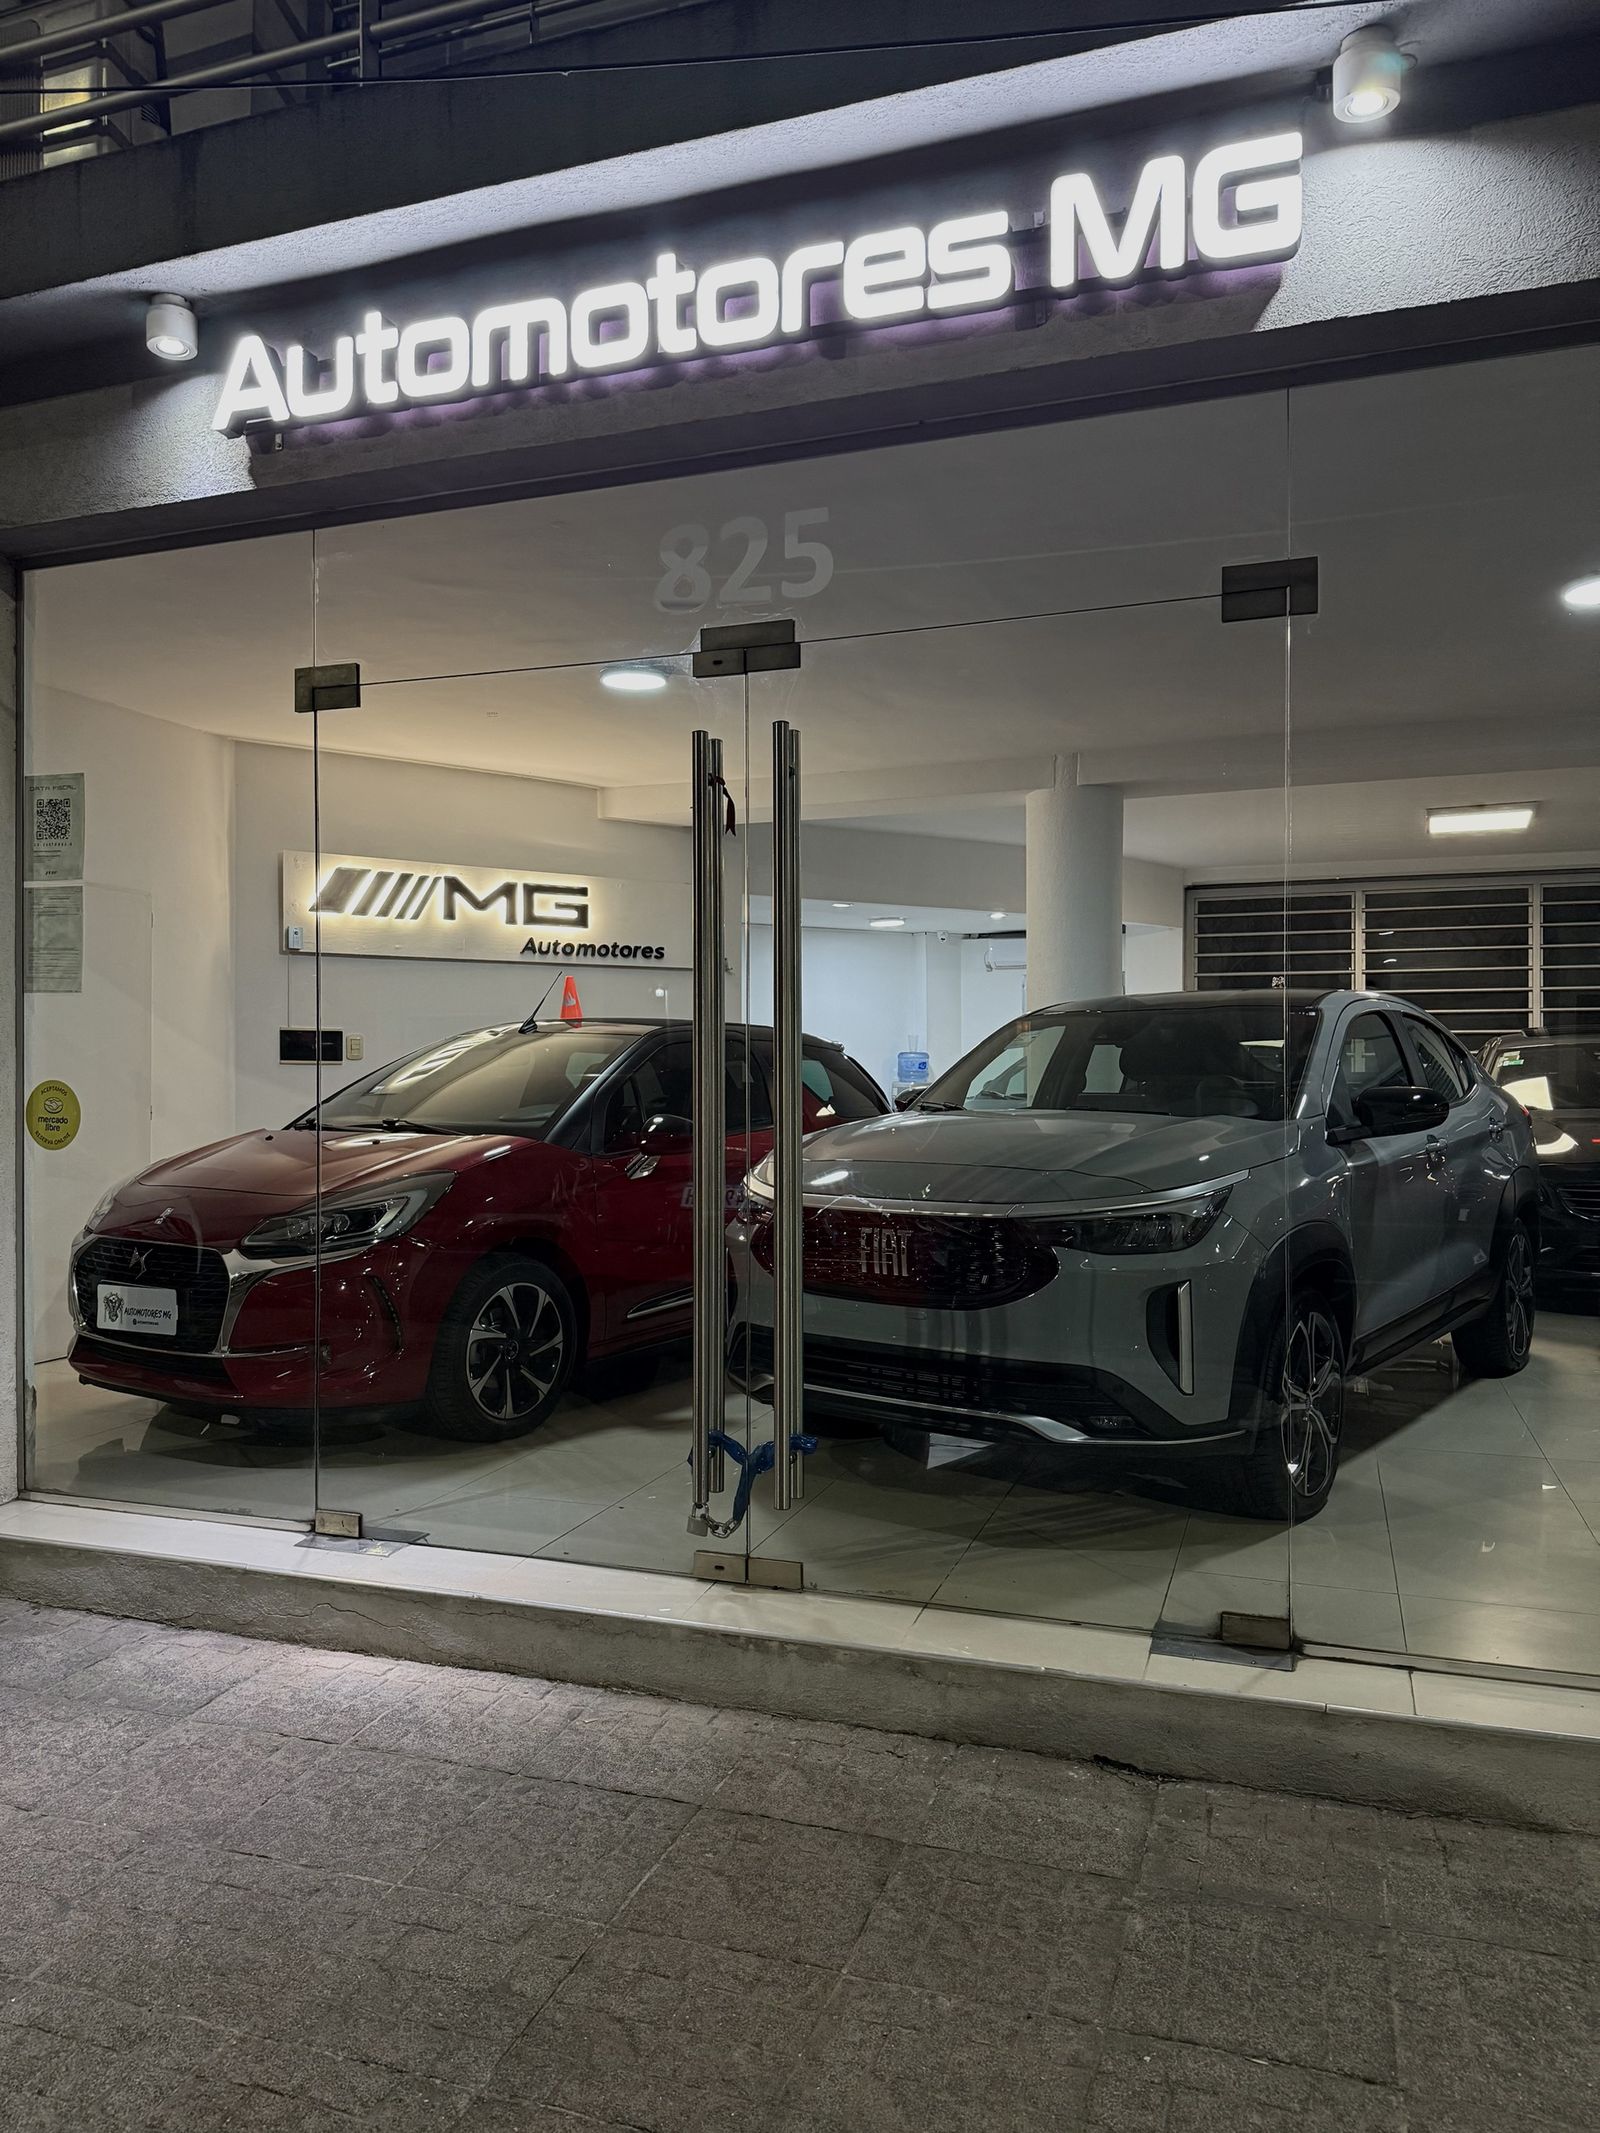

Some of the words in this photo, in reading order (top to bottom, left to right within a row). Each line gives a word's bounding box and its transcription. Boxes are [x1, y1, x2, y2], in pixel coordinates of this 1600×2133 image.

[212, 211, 1014, 430] Automotores
[1050, 131, 1302, 288] MG
[655, 507, 834, 614] 825
[444, 875, 588, 928] MG
[520, 937, 665, 959] Automotores
[38, 1116, 68, 1124] mercado
[45, 1123, 60, 1131] libre
[860, 1227, 914, 1276] FIAT
[124, 1307, 162, 1319] AUTOMOTORES
[162, 1310, 172, 1320] MG
